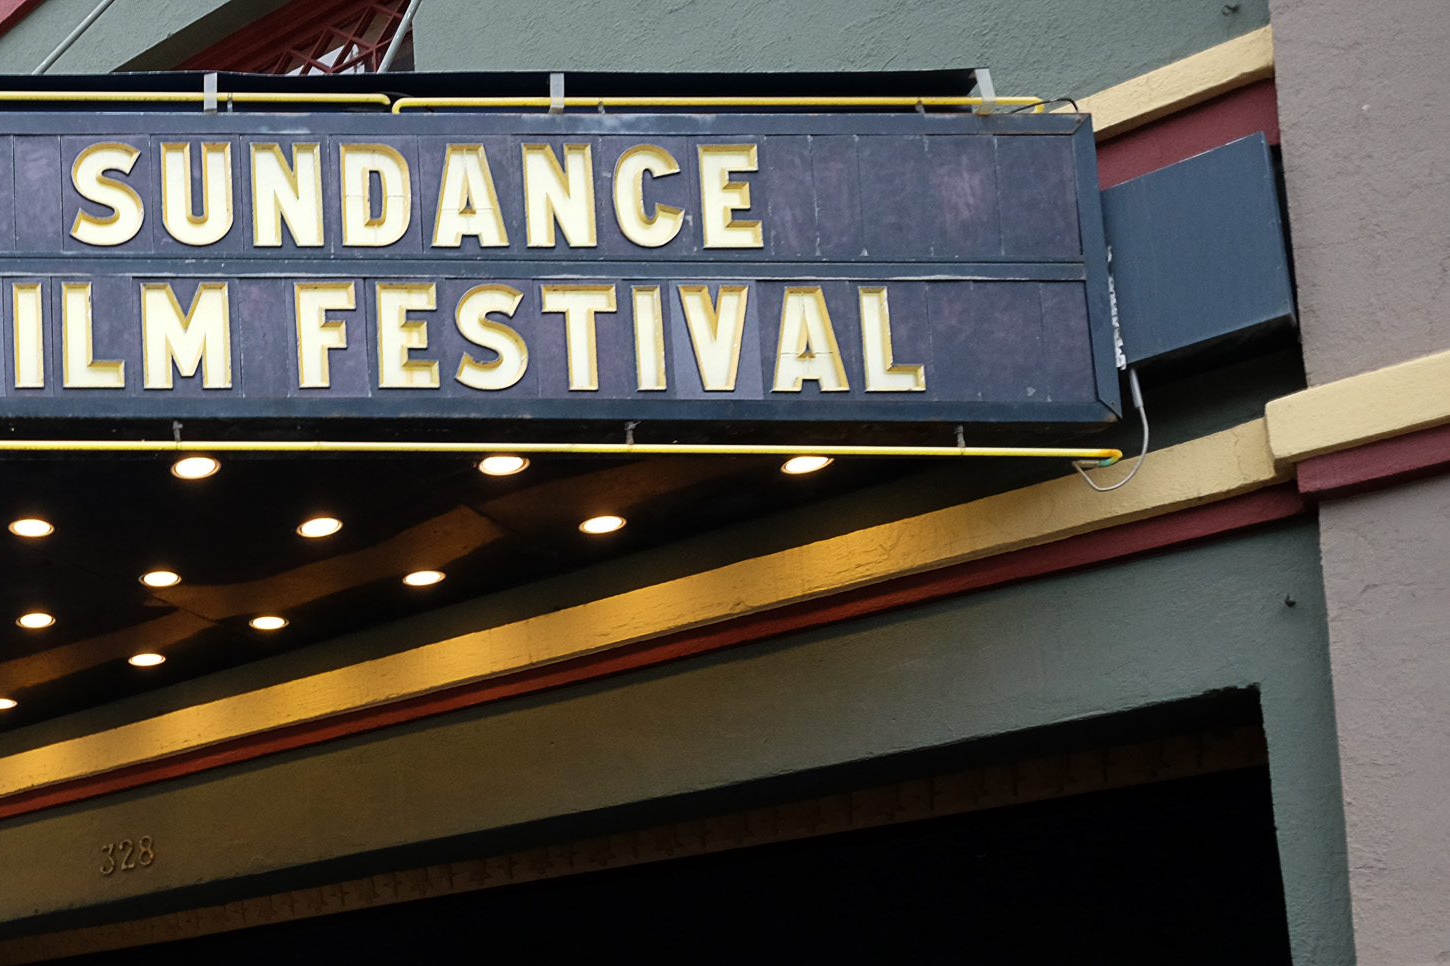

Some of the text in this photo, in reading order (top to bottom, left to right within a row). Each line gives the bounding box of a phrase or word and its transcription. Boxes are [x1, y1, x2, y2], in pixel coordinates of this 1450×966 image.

[69, 141, 764, 249] SUNDANCE
[293, 280, 929, 393] FESTIVAL
[100, 835, 154, 875] 328
